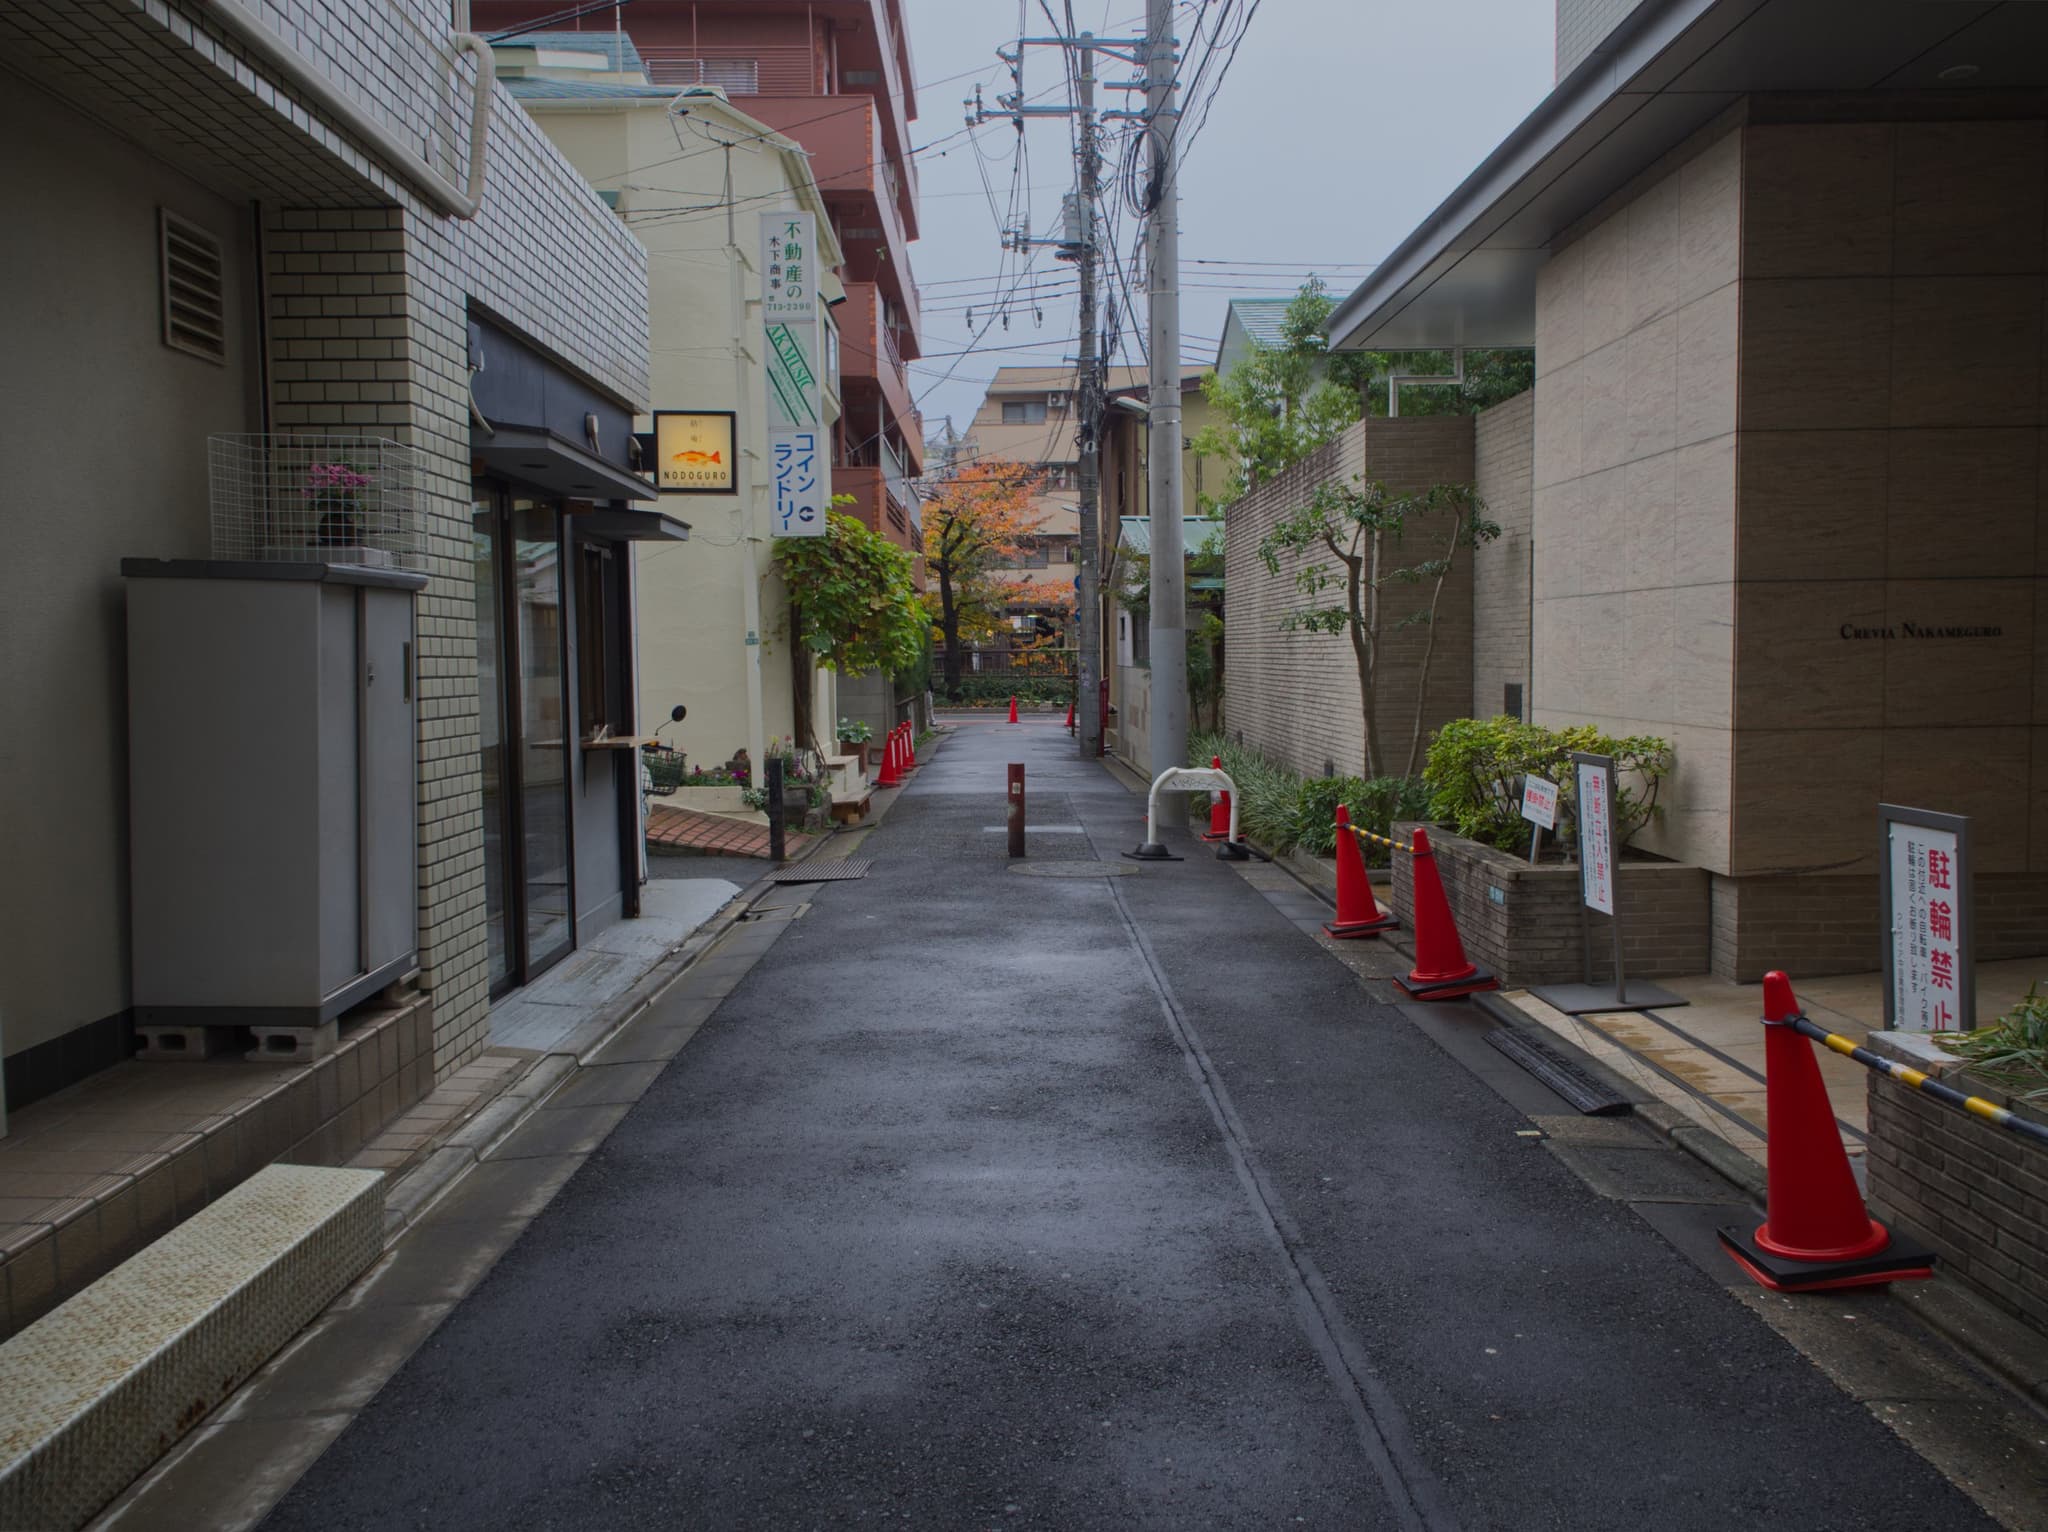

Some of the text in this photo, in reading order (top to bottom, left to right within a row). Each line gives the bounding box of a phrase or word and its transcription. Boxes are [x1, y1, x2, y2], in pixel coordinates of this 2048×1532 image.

[784, 221, 802, 298] 不動産の
[784, 346, 812, 390] MUSIC
[664, 471, 726, 480] NODOGURO
[795, 434, 815, 492] コイン
[1928, 849, 1952, 1031] 駐輪禁止
